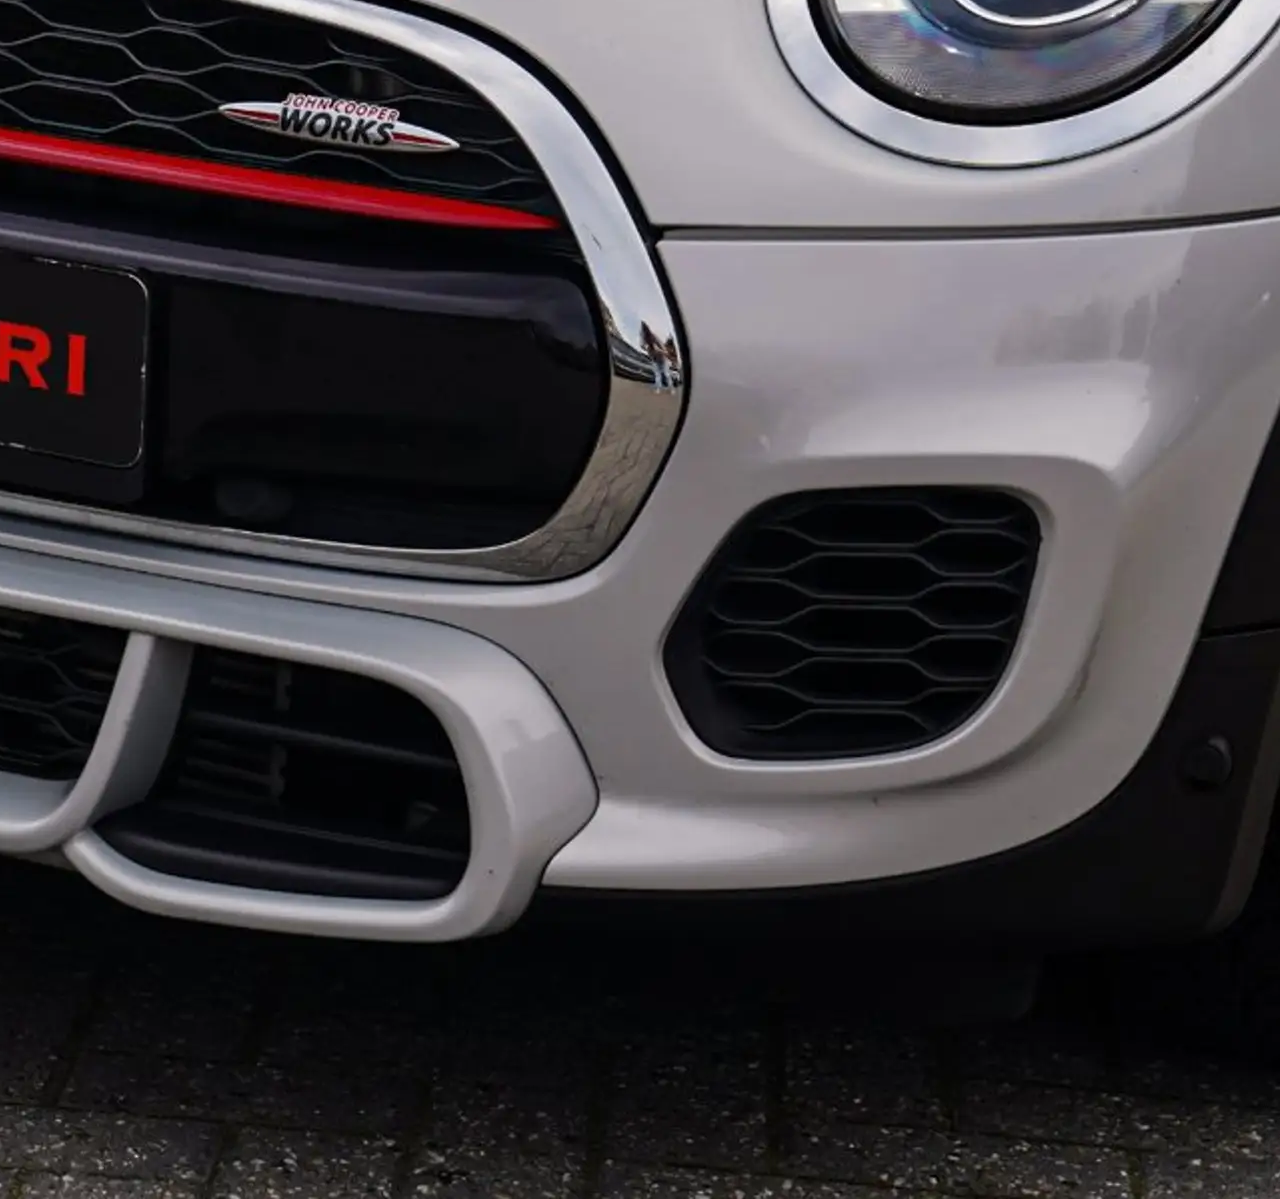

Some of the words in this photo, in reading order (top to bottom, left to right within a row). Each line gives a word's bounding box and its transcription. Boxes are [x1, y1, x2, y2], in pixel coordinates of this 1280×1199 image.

[282, 92, 333, 111] JOHN
[333, 99, 401, 122] COOPER
[279, 107, 396, 147] WORKS
